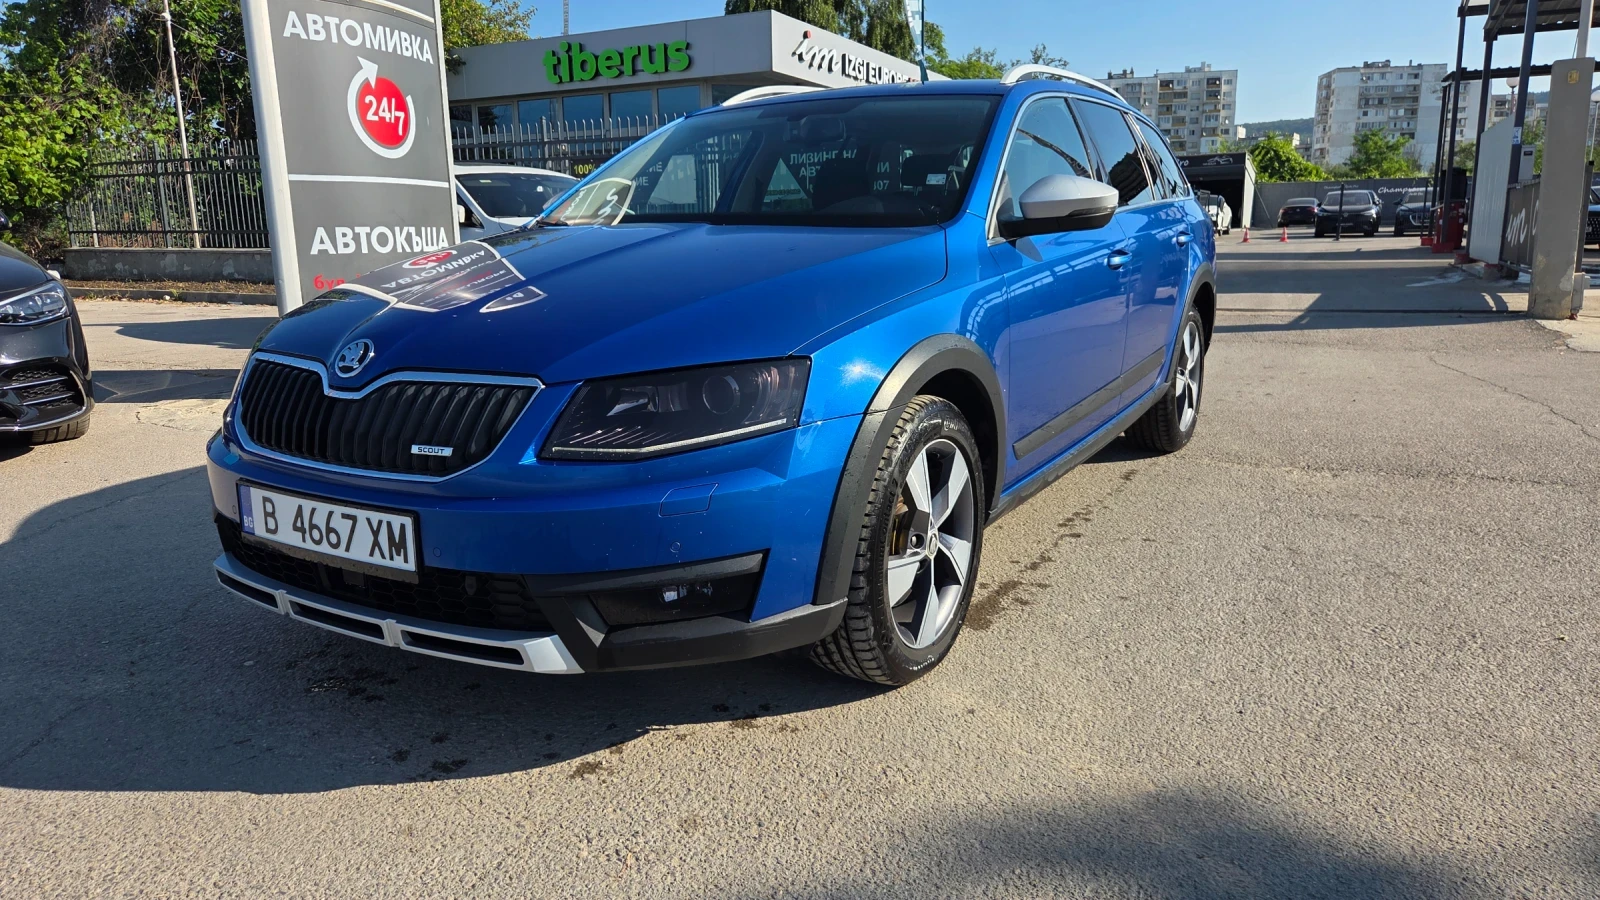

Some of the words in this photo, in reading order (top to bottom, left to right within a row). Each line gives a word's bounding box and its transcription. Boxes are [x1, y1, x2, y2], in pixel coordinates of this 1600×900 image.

[283, 10, 434, 65] АВТОМИВКА
[542, 39, 688, 84] tiberus
[842, 53, 867, 81] IZGI
[364, 94, 405, 136] 24/7
[417, 446, 445, 454] SCOUT
[244, 515, 254, 527] BG
[262, 495, 279, 535] B
[292, 504, 357, 552] 4667
[366, 517, 409, 564] XM
